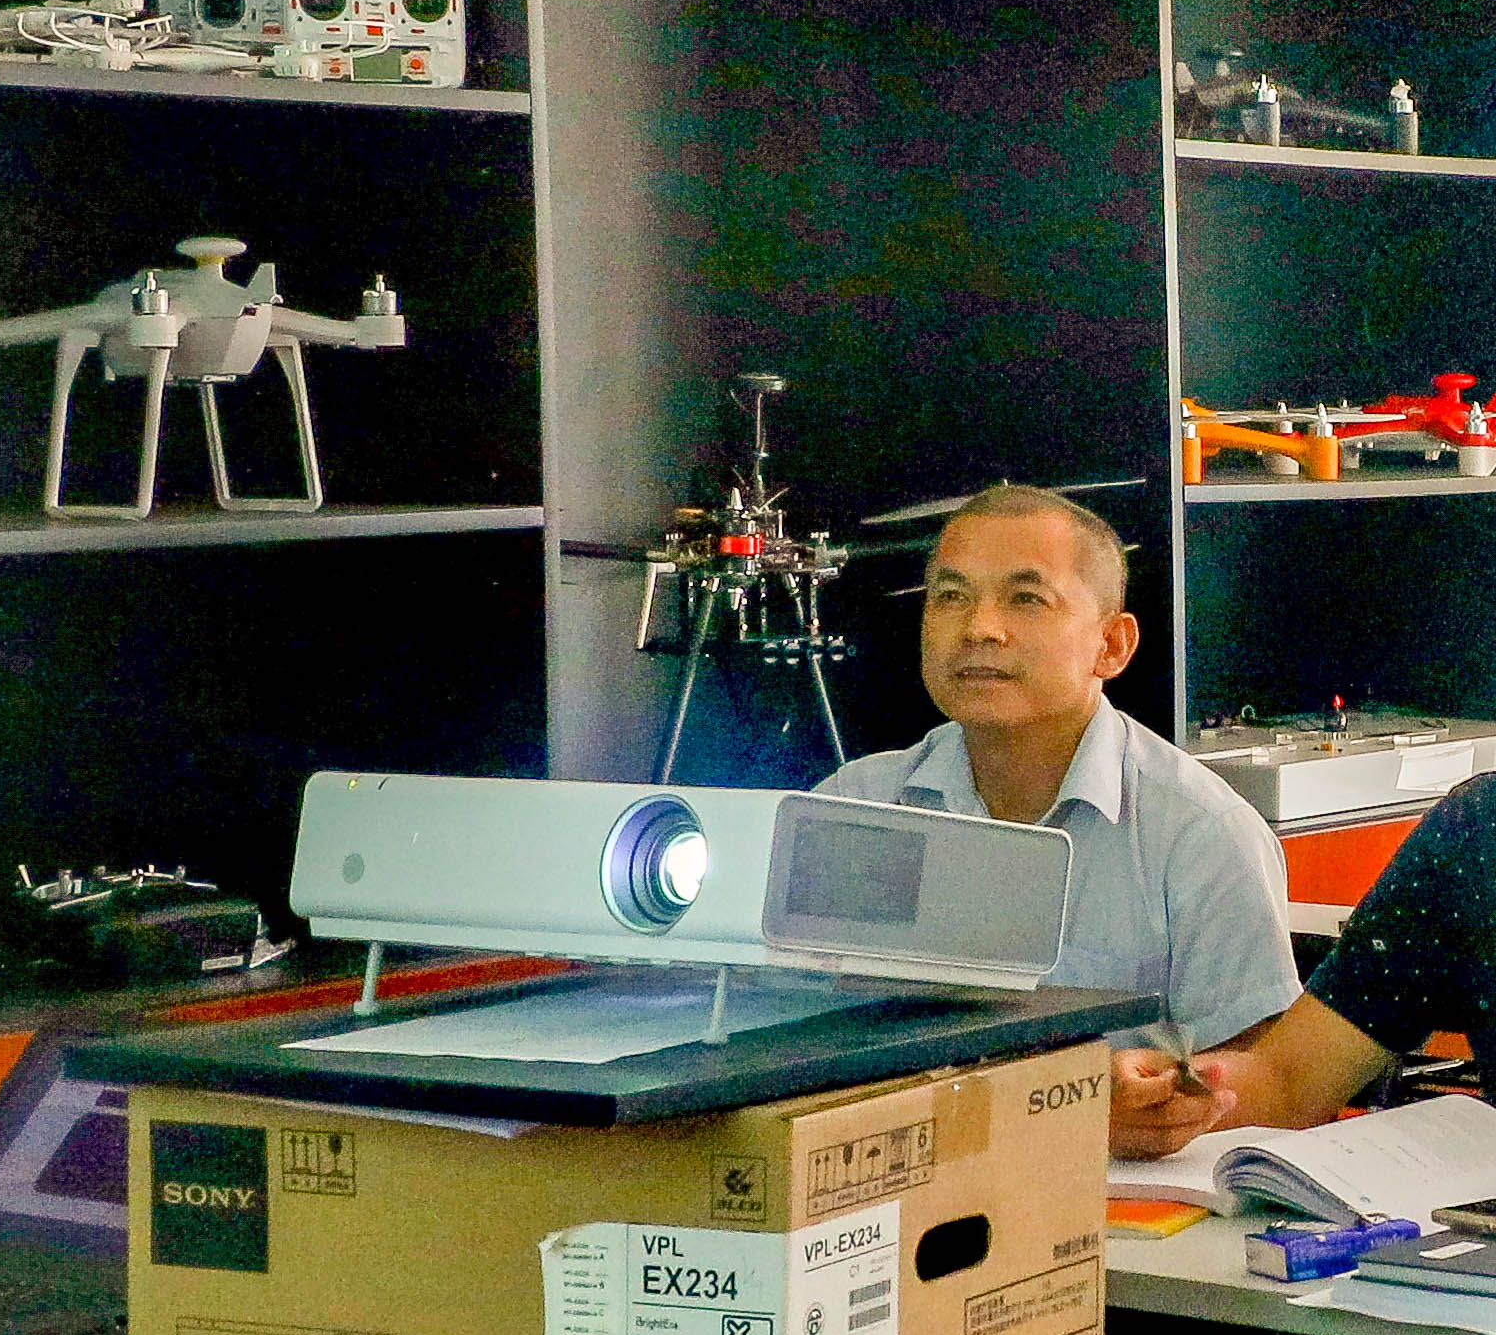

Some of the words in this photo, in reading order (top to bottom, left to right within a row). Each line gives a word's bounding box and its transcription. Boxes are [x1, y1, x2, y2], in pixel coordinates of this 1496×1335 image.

[1027, 1073, 1105, 1115] SONY
[163, 1181, 255, 1209] SONY
[642, 1234, 685, 1257] VPL
[804, 1222, 881, 1264] VPL-EX234
[642, 1264, 738, 1301] EX234
